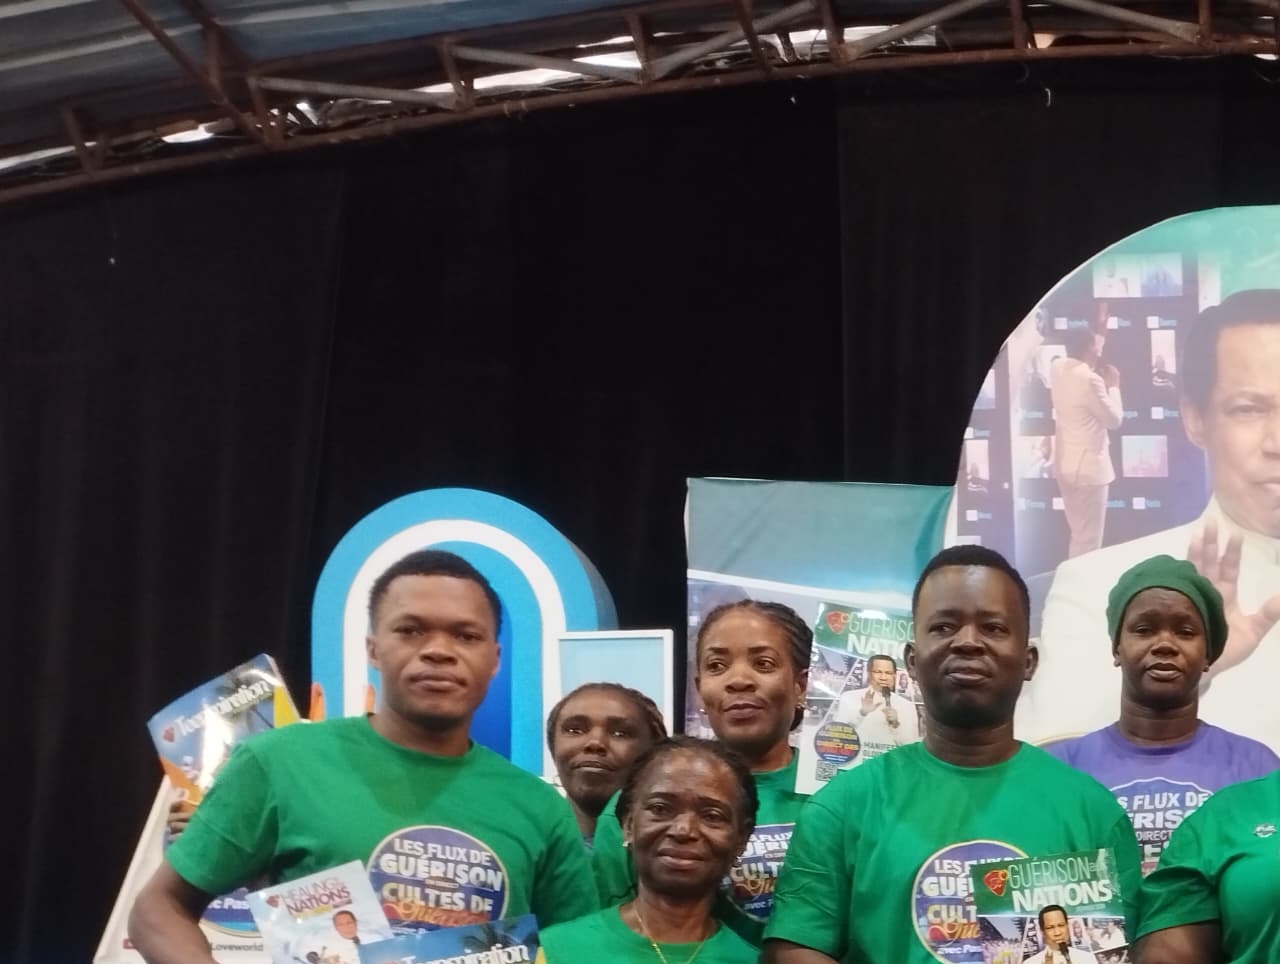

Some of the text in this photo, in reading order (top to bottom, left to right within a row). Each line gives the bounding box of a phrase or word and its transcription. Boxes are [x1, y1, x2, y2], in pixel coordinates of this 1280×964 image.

[1132, 791, 1181, 810] FLUX
[1136, 830, 1172, 842] DIRECT
[393, 838, 493, 866] LES FLUX DE
[379, 852, 504, 892] GUÉRISON
[730, 861, 785, 881] CULT
[934, 859, 963, 875] LES
[1007, 856, 1092, 889] GUÉRISON
[286, 885, 351, 915] NATIONS
[382, 881, 494, 914] CULTES DE
[1011, 879, 1113, 913] NATIONS
[927, 903, 978, 924] CULT
